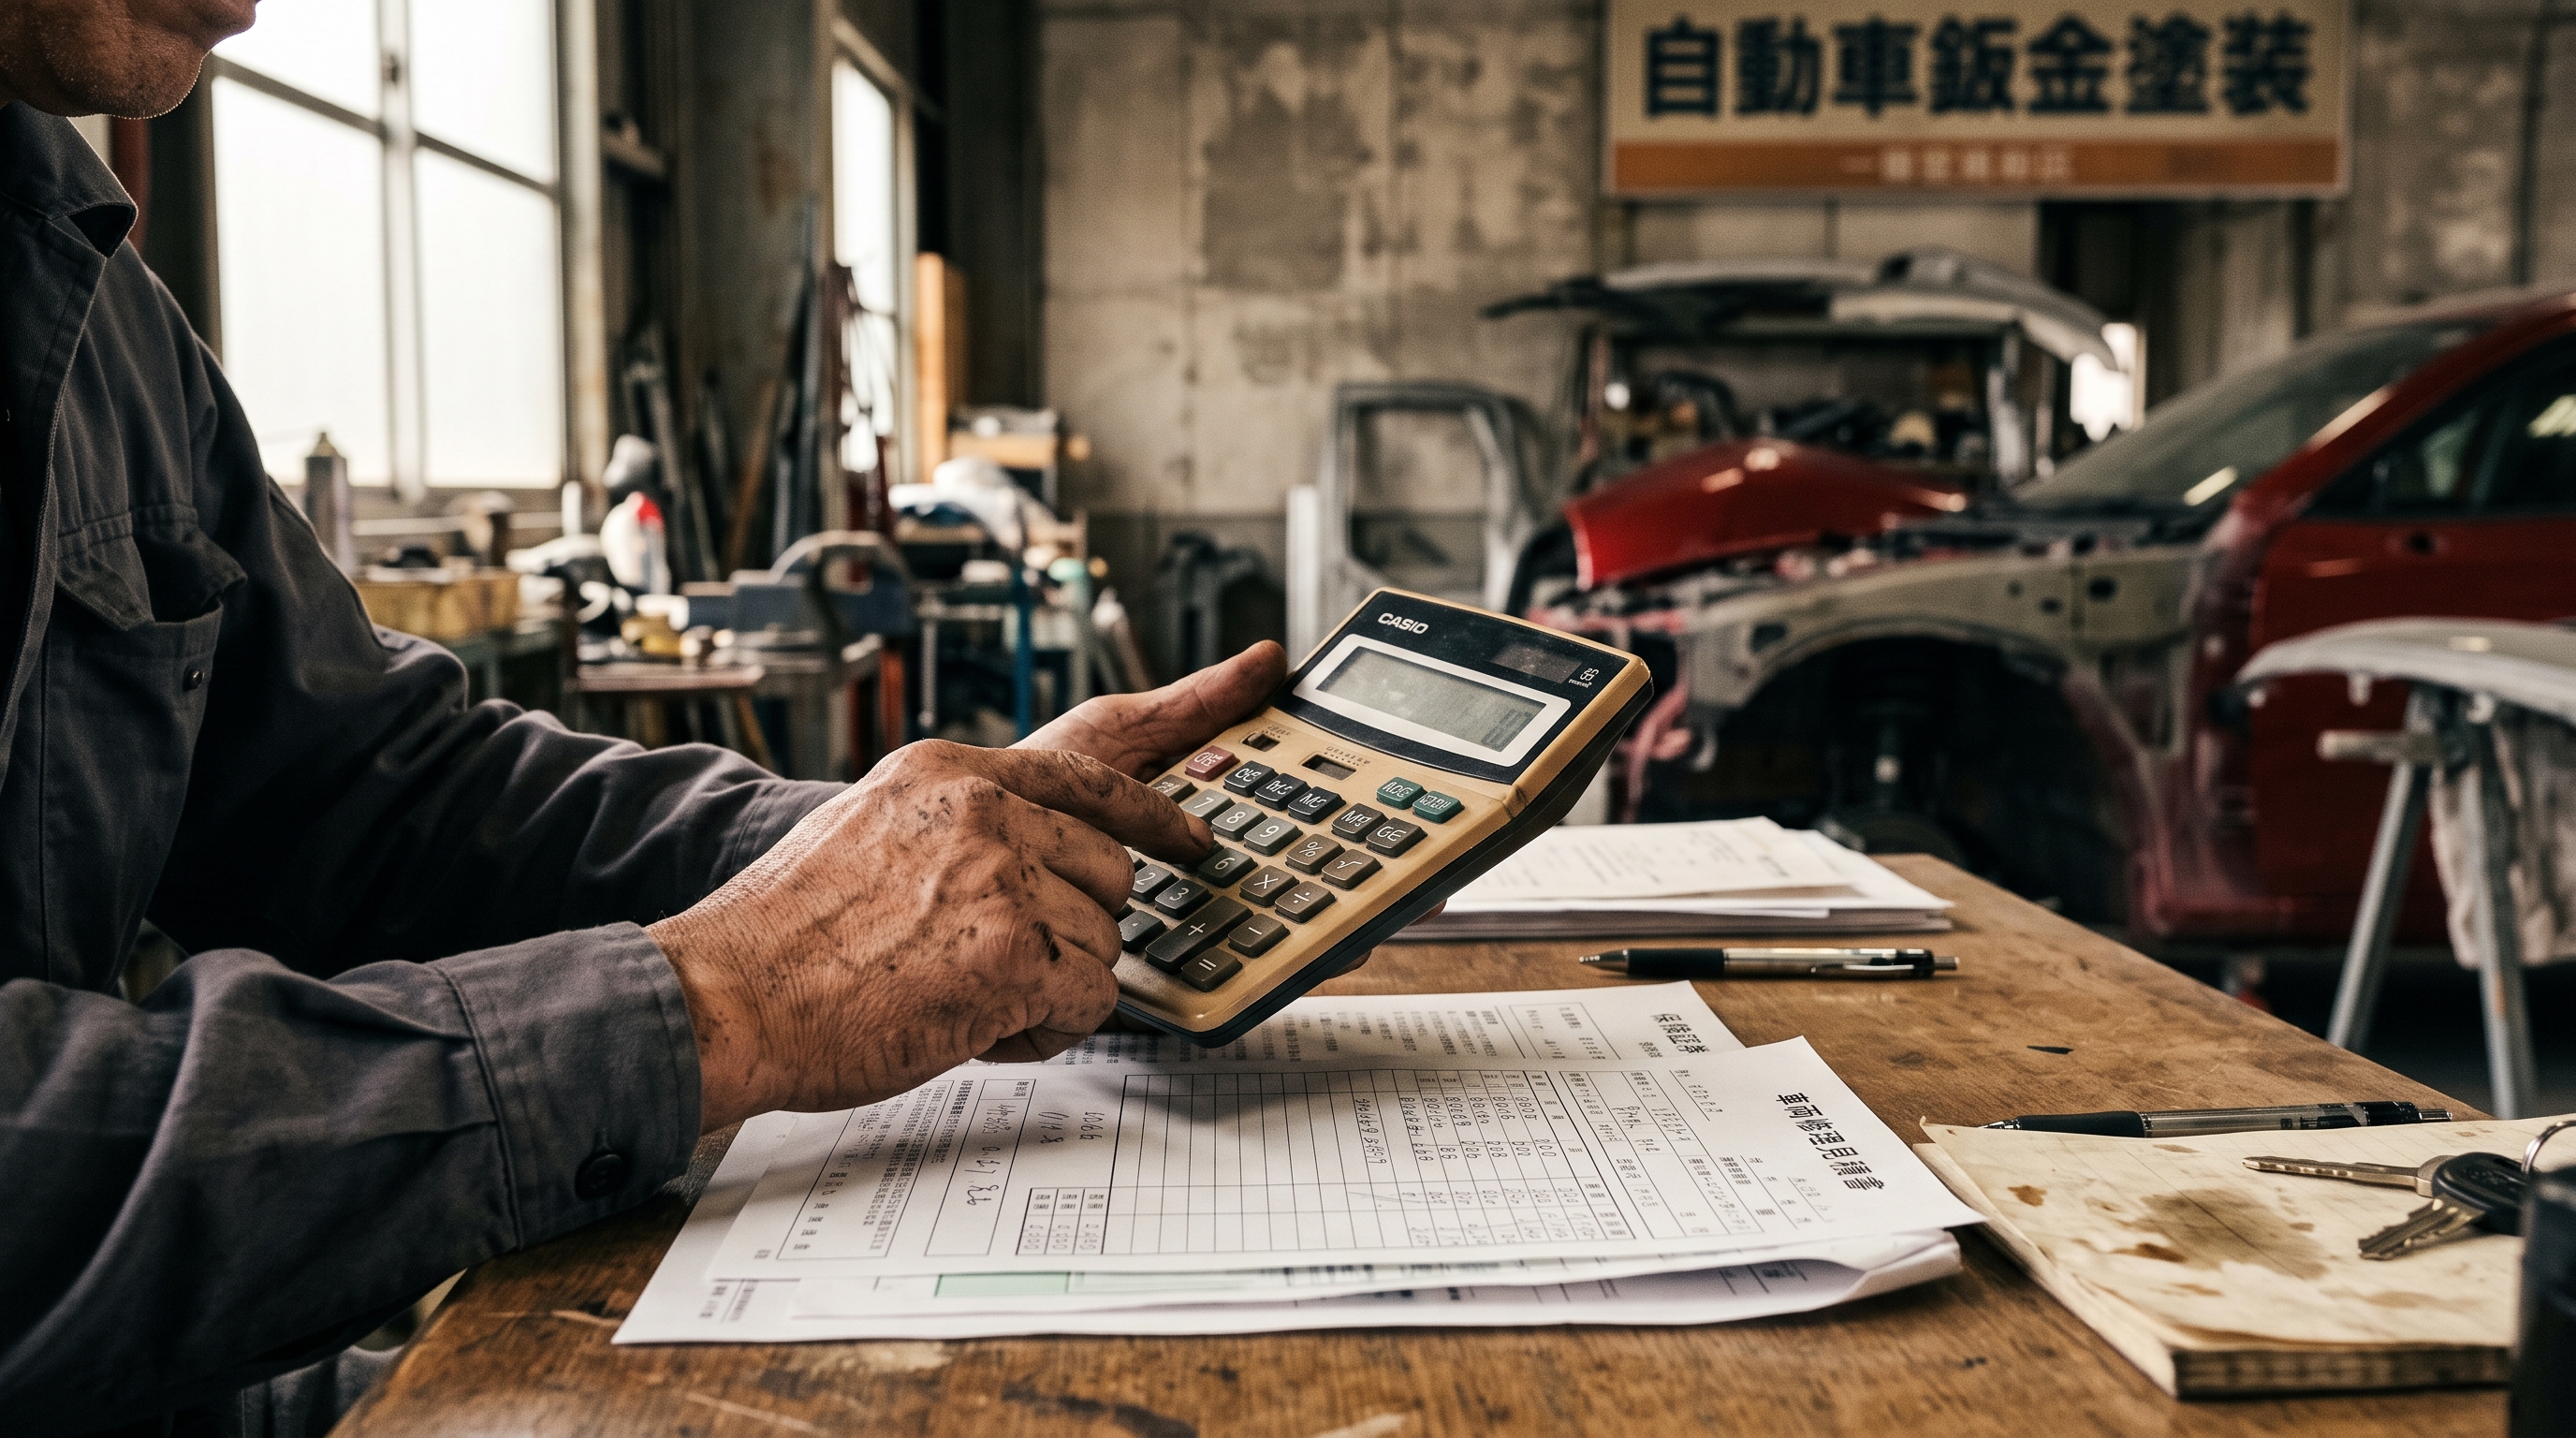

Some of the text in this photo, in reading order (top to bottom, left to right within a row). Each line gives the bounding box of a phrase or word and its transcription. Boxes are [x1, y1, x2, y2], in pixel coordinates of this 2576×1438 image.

[1644, 13, 2314, 118] 自動車鈑金塗装
[1377, 612, 1429, 635] CASIO
[1193, 797, 1215, 809] 7
[1225, 811, 1247, 824] 8
[1259, 825, 1280, 838] 9
[1298, 842, 1324, 858] %
[1214, 857, 1236, 870] 6
[1135, 872, 1156, 886] 2
[1169, 888, 1190, 902] 3
